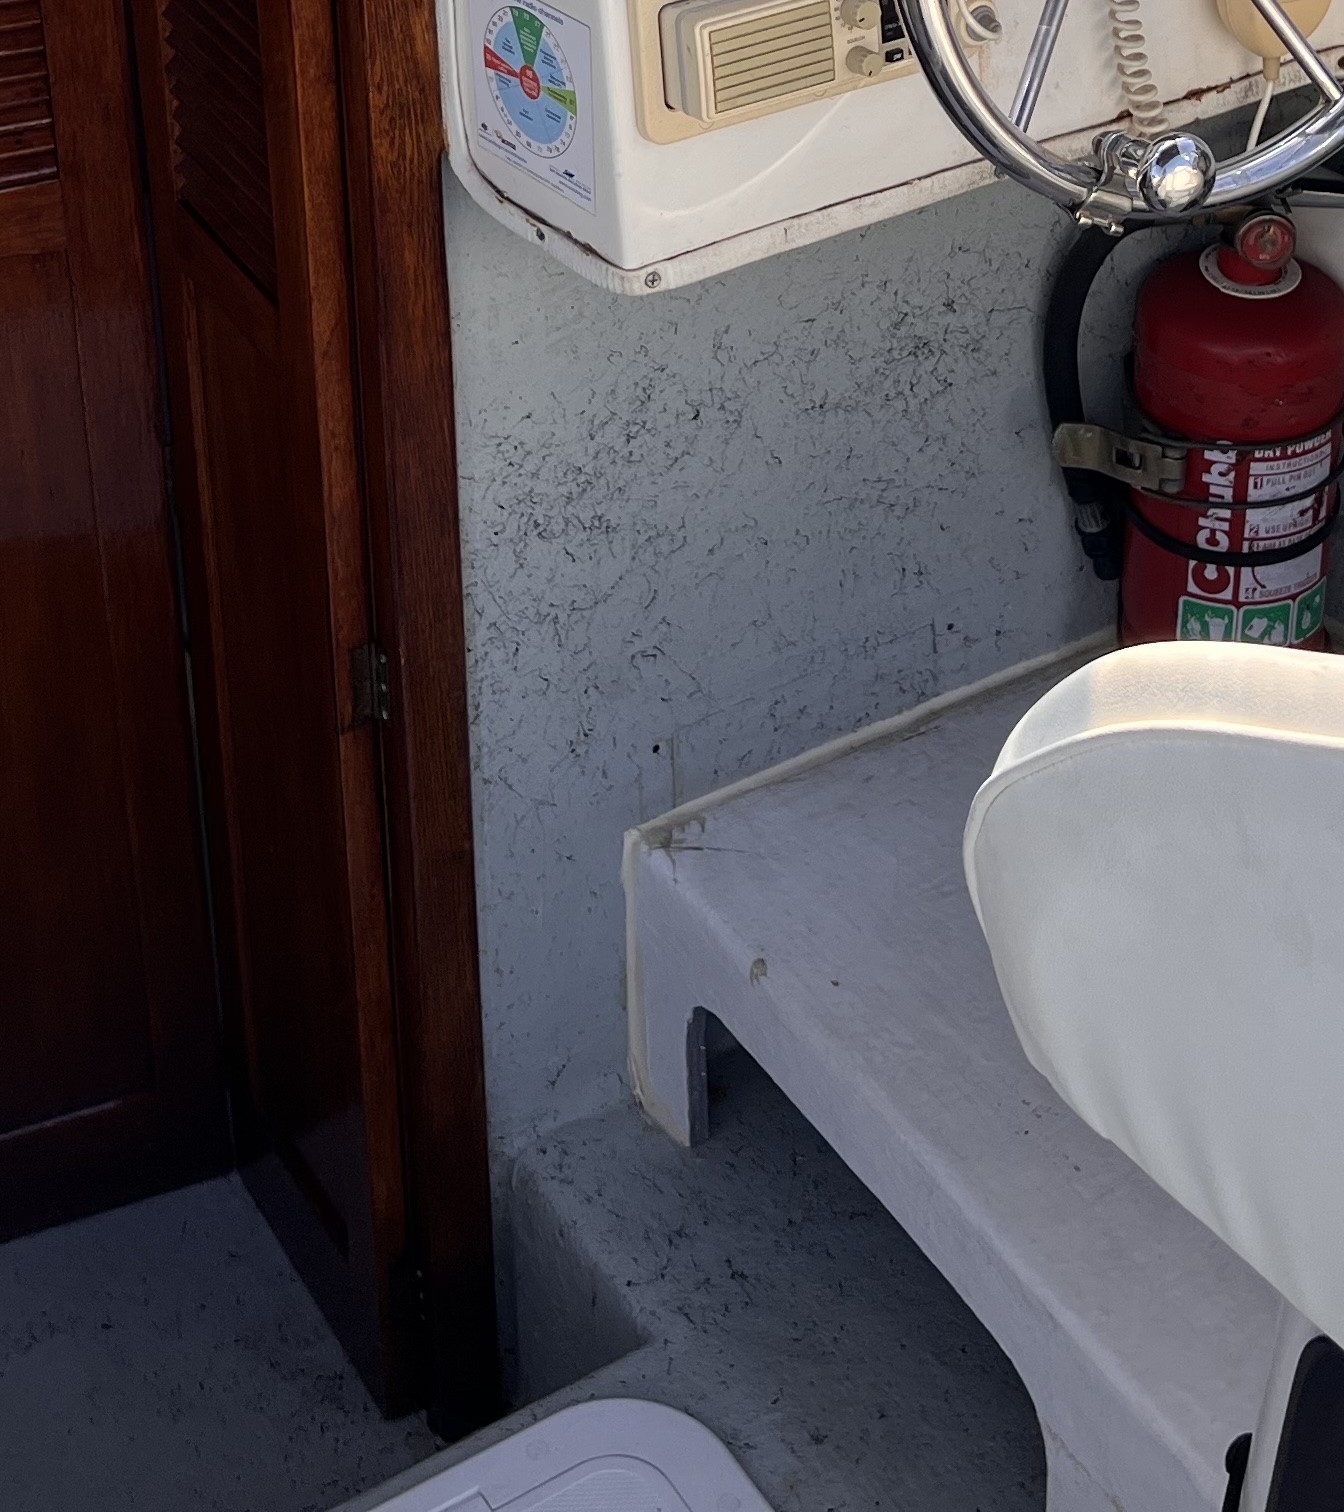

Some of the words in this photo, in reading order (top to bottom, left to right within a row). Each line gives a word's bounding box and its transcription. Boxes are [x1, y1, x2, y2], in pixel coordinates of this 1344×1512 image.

[1254, 446, 1281, 458] DRY
[1266, 477, 1285, 486] PULL
[1289, 474, 1301, 483] PIN
[1196, 440, 1237, 553] Chubb
[1264, 524, 1280, 534] USE
